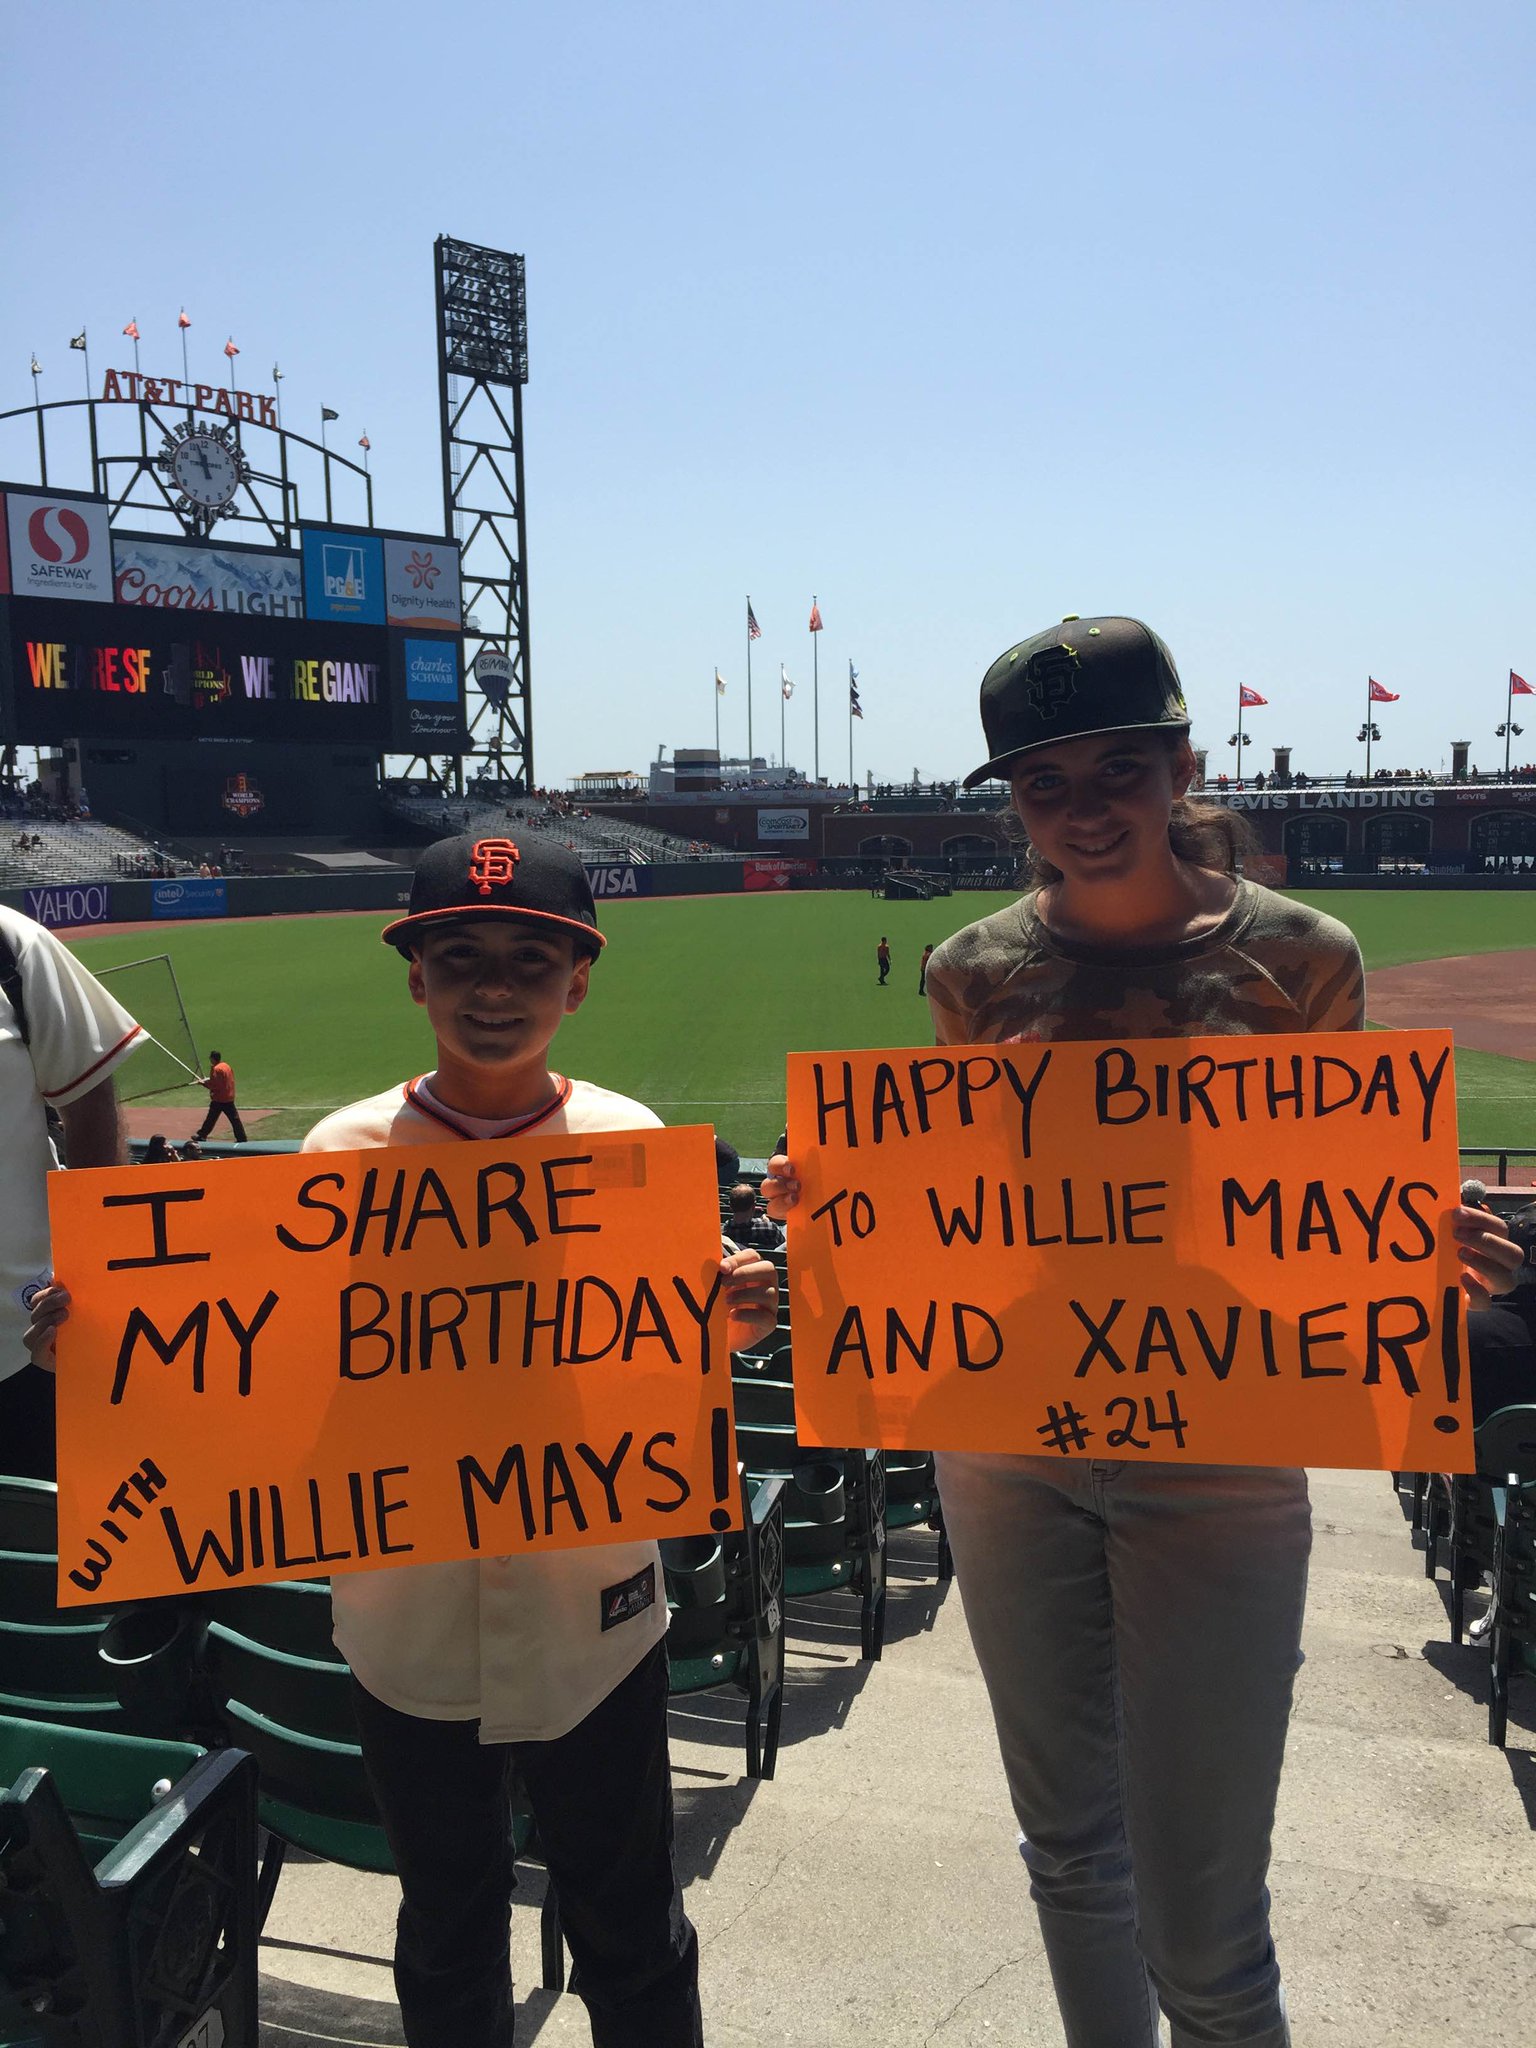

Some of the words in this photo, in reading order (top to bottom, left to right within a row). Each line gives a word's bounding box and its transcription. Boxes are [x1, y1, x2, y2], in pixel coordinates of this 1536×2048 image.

[103, 369, 181, 406] AT&T
[195, 384, 277, 429] PARK
[30, 563, 92, 581] SAFEWAY
[115, 567, 219, 612] Coors
[222, 589, 304, 619] LIGHT
[327, 575, 363, 597] PG&E
[391, 594, 424, 609] Dignity
[427, 599, 456, 609] Health
[27, 642, 69, 689] WE
[122, 648, 151, 693] SF
[241, 656, 277, 699] WE
[411, 673, 453, 684] SCHWAB
[1299, 791, 1435, 808] LANDING
[158, 884, 180, 898] intel
[469, 838, 520, 895] SF
[584, 868, 638, 894] VISA
[957, 877, 982, 886] TRIPLES
[984, 877, 1006, 886] ALLEY
[29, 885, 108, 924] YAHOO!
[813, 1049, 1052, 1158] HAPPY
[1095, 1047, 1449, 1142] BIRTHDAY
[103, 1189, 210, 1270] I
[276, 1155, 601, 1257] SHARE
[811, 1189, 875, 1246] TO
[927, 1176, 1168, 1247] WILLIE
[1222, 1177, 1438, 1262] MAYS
[111, 1290, 279, 1405] MY
[340, 1276, 722, 1380] BIRTHDAY
[827, 1301, 1003, 1379] AND
[1069, 1286, 1461, 1434] XAVIER!
[1037, 1390, 1188, 1455] #24
[69, 1458, 167, 1591] WITH
[160, 1466, 414, 1584] WILLIE
[457, 1408, 731, 1531] MAYS!
